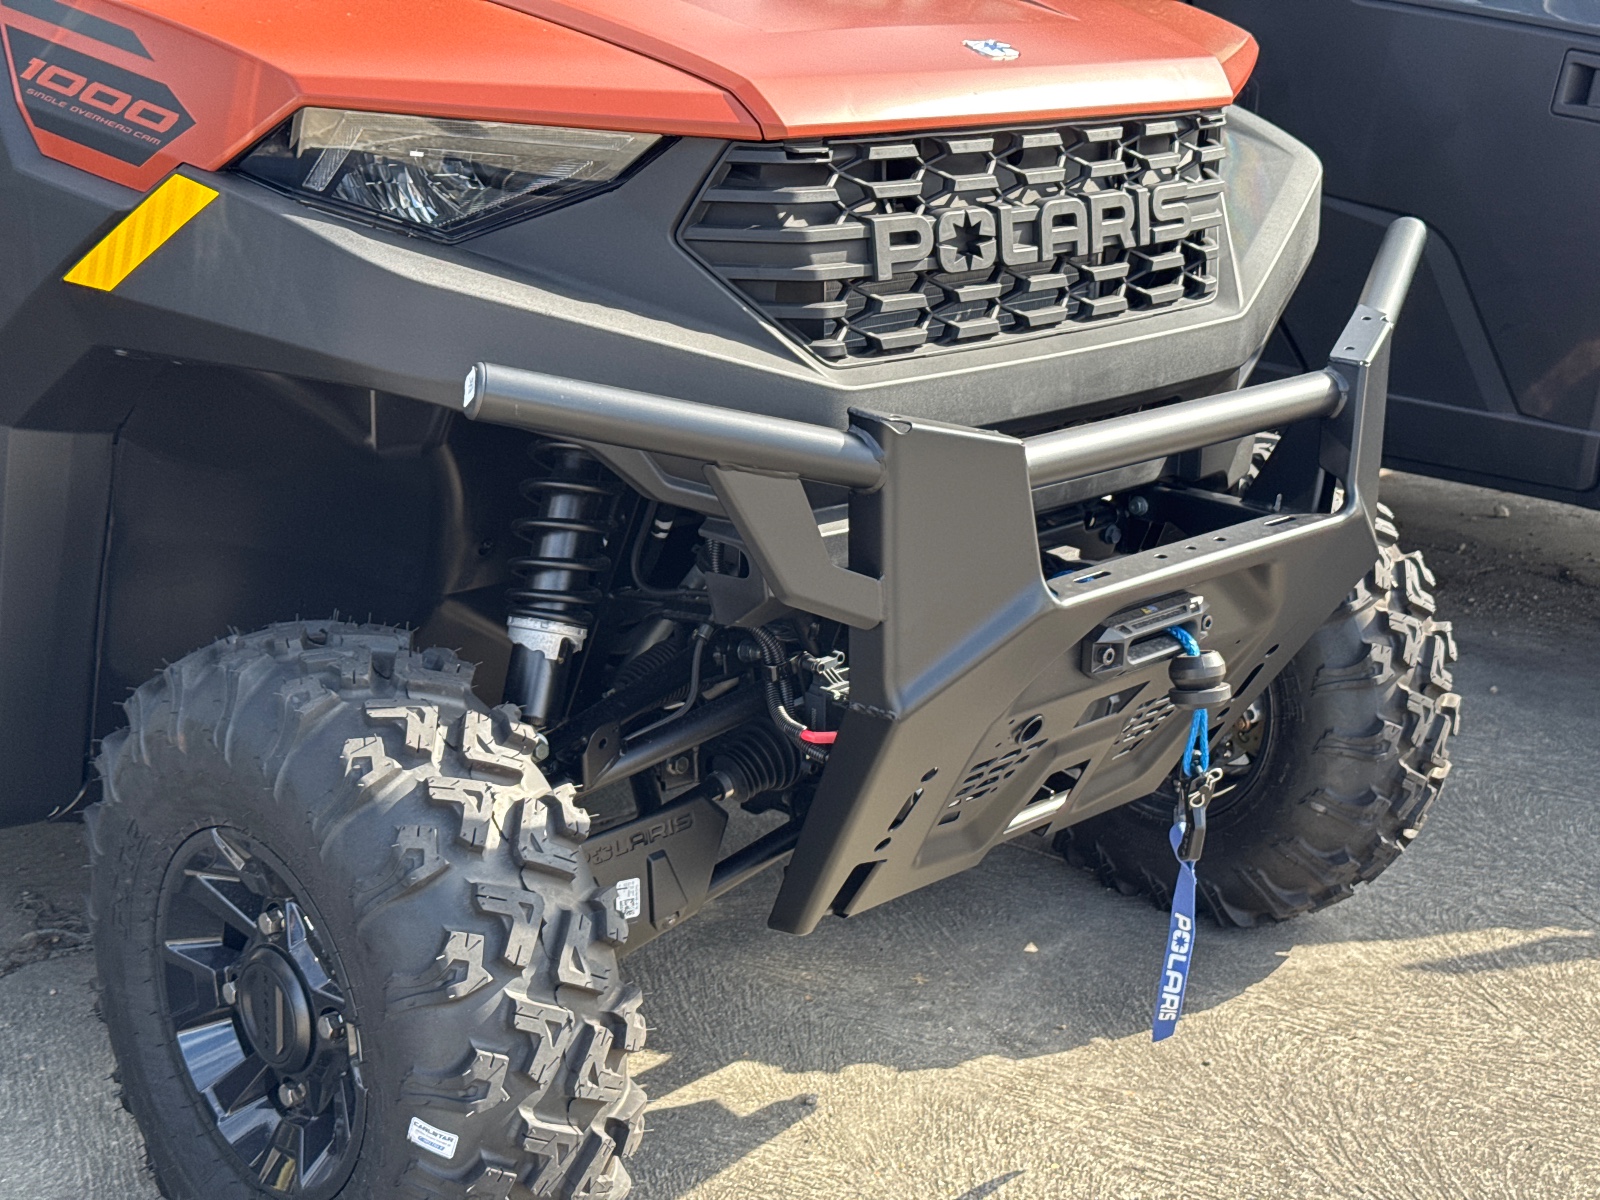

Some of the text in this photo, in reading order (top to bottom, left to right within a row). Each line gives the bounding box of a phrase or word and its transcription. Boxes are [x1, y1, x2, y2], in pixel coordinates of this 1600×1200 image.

[20, 57, 180, 133] 1000
[26, 88, 162, 146] SINGLE OVERHEAD CAM
[872, 182, 1191, 281] POLARIS
[586, 812, 695, 865] OLARIS
[1158, 912, 1192, 1021] POLARIS
